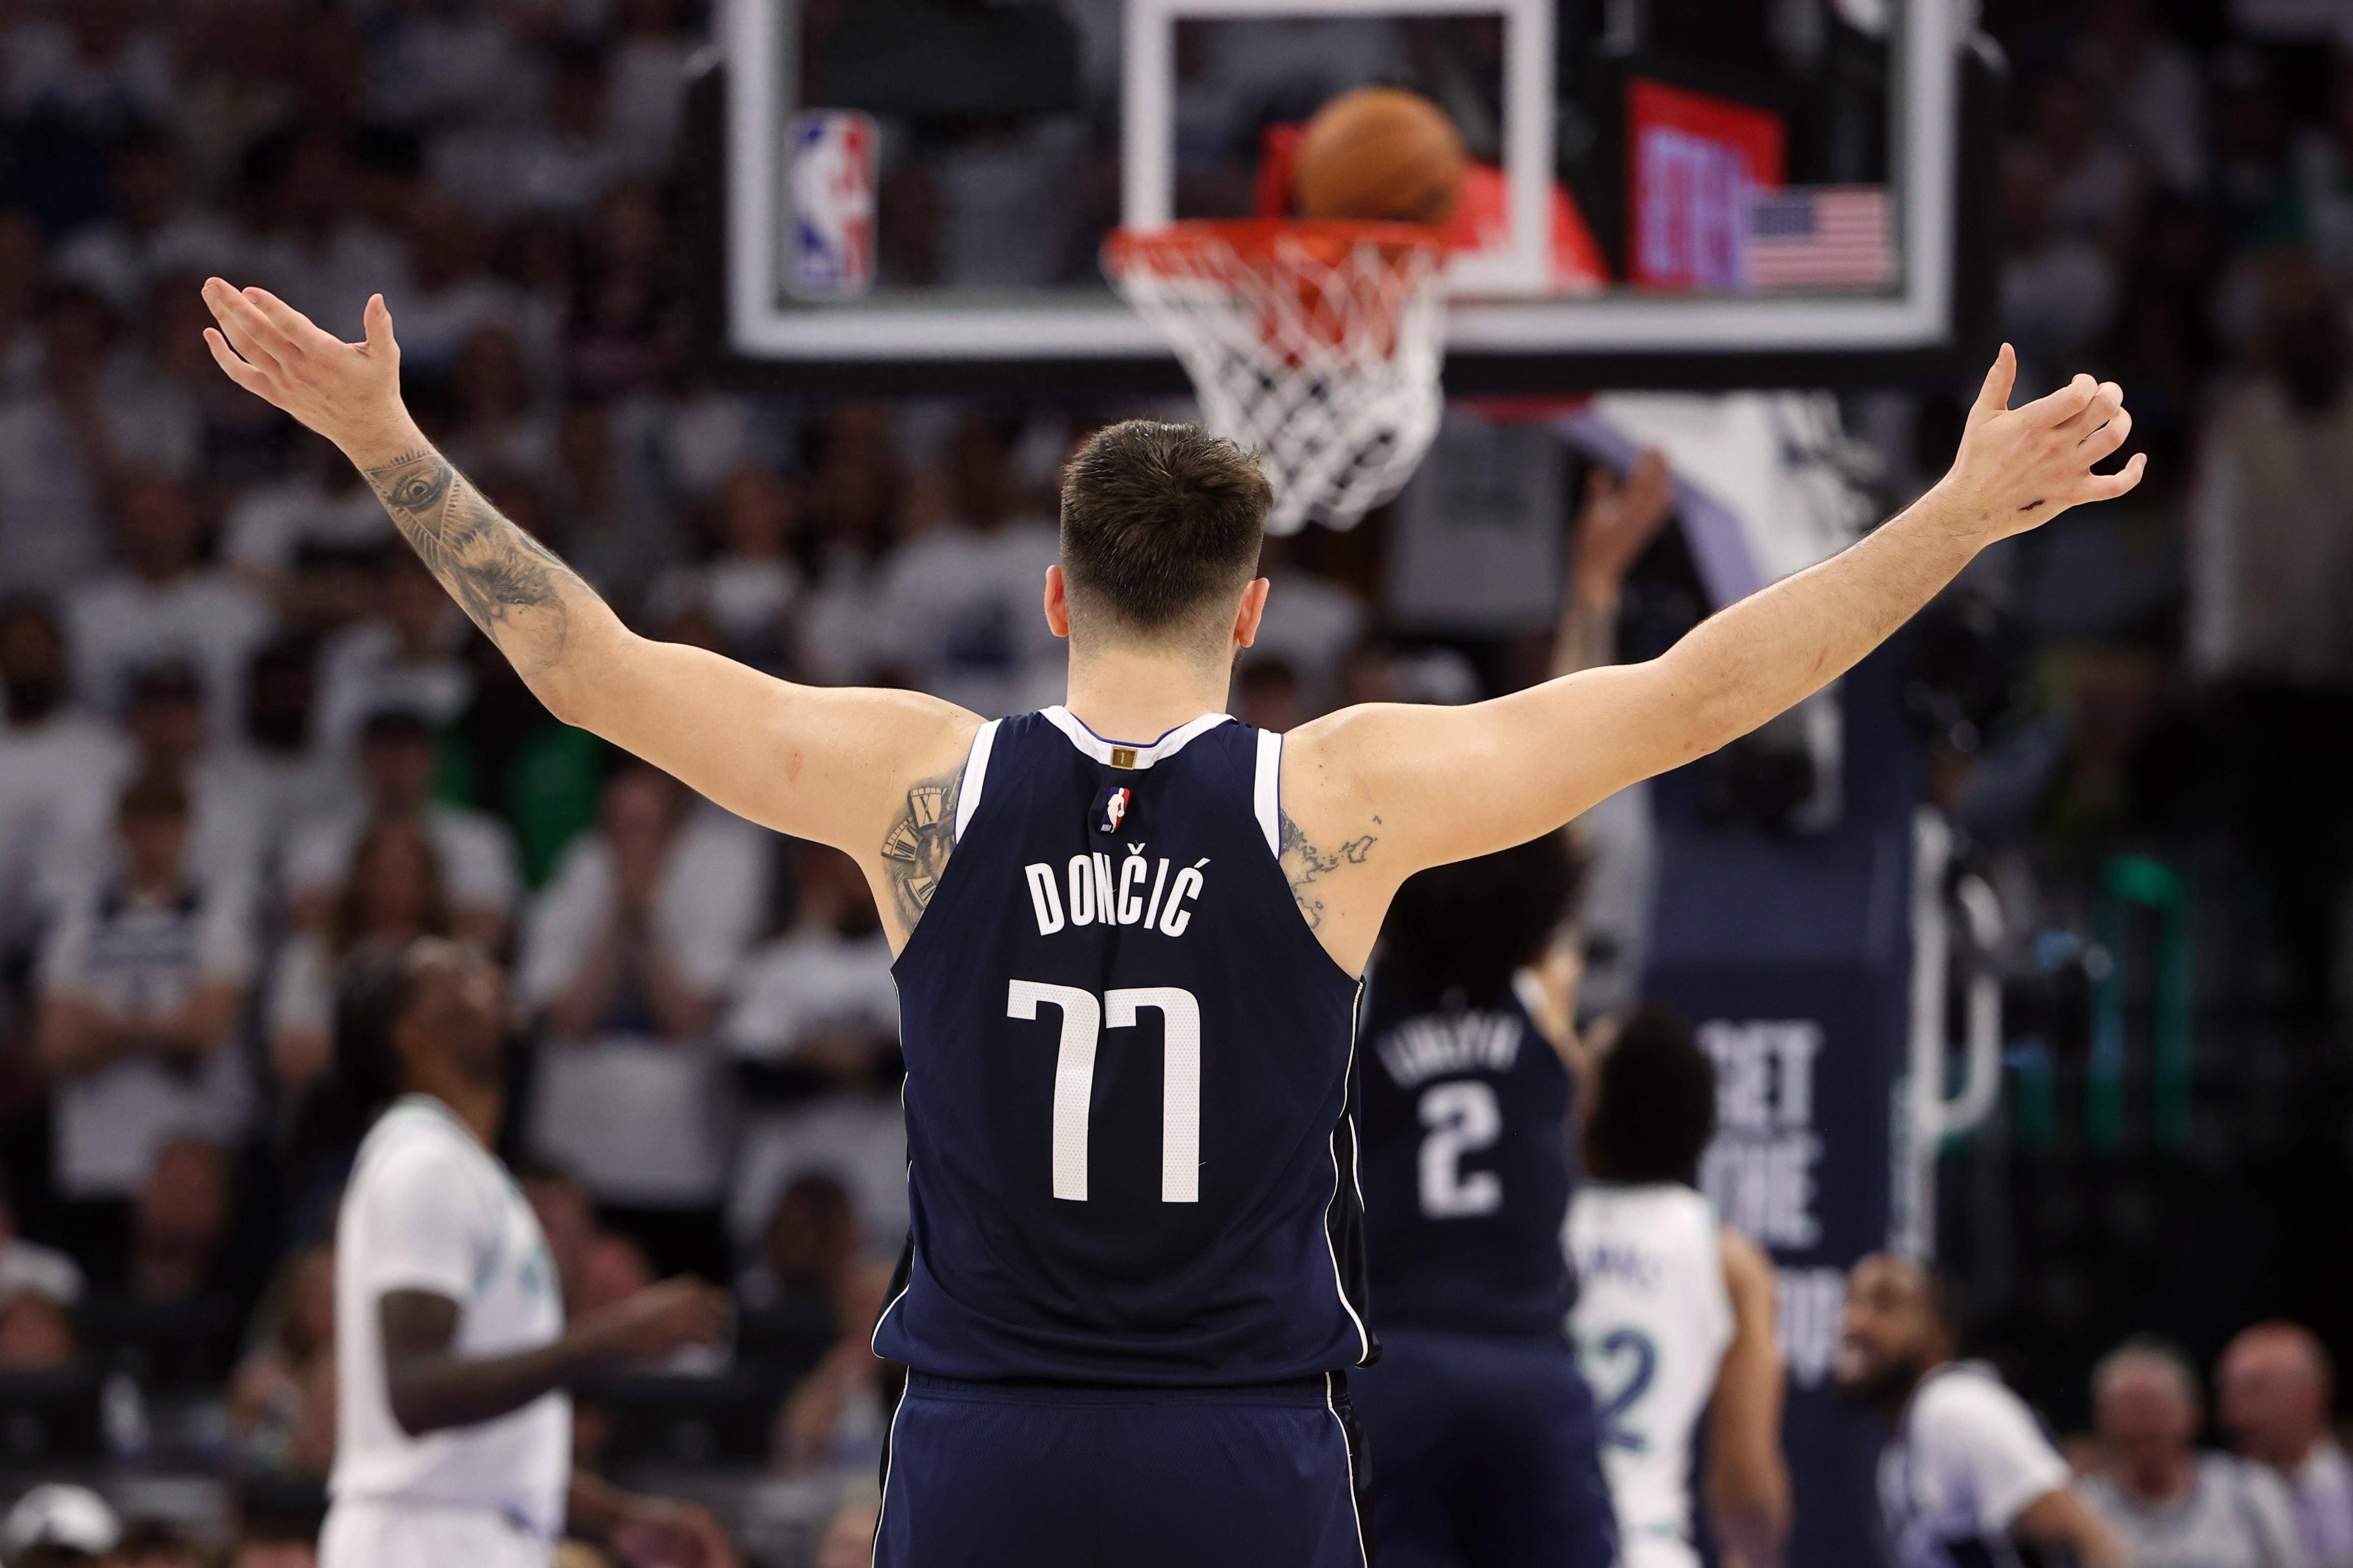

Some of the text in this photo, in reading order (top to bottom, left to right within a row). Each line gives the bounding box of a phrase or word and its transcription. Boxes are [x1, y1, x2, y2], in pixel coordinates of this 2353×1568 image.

[1120, 752, 1125, 764] 1
[1100, 824, 1112, 832] NBA
[1025, 843, 1211, 937] DONČIĆ
[1007, 979, 1201, 1202] 77
[1418, 1079, 1503, 1219] 2
